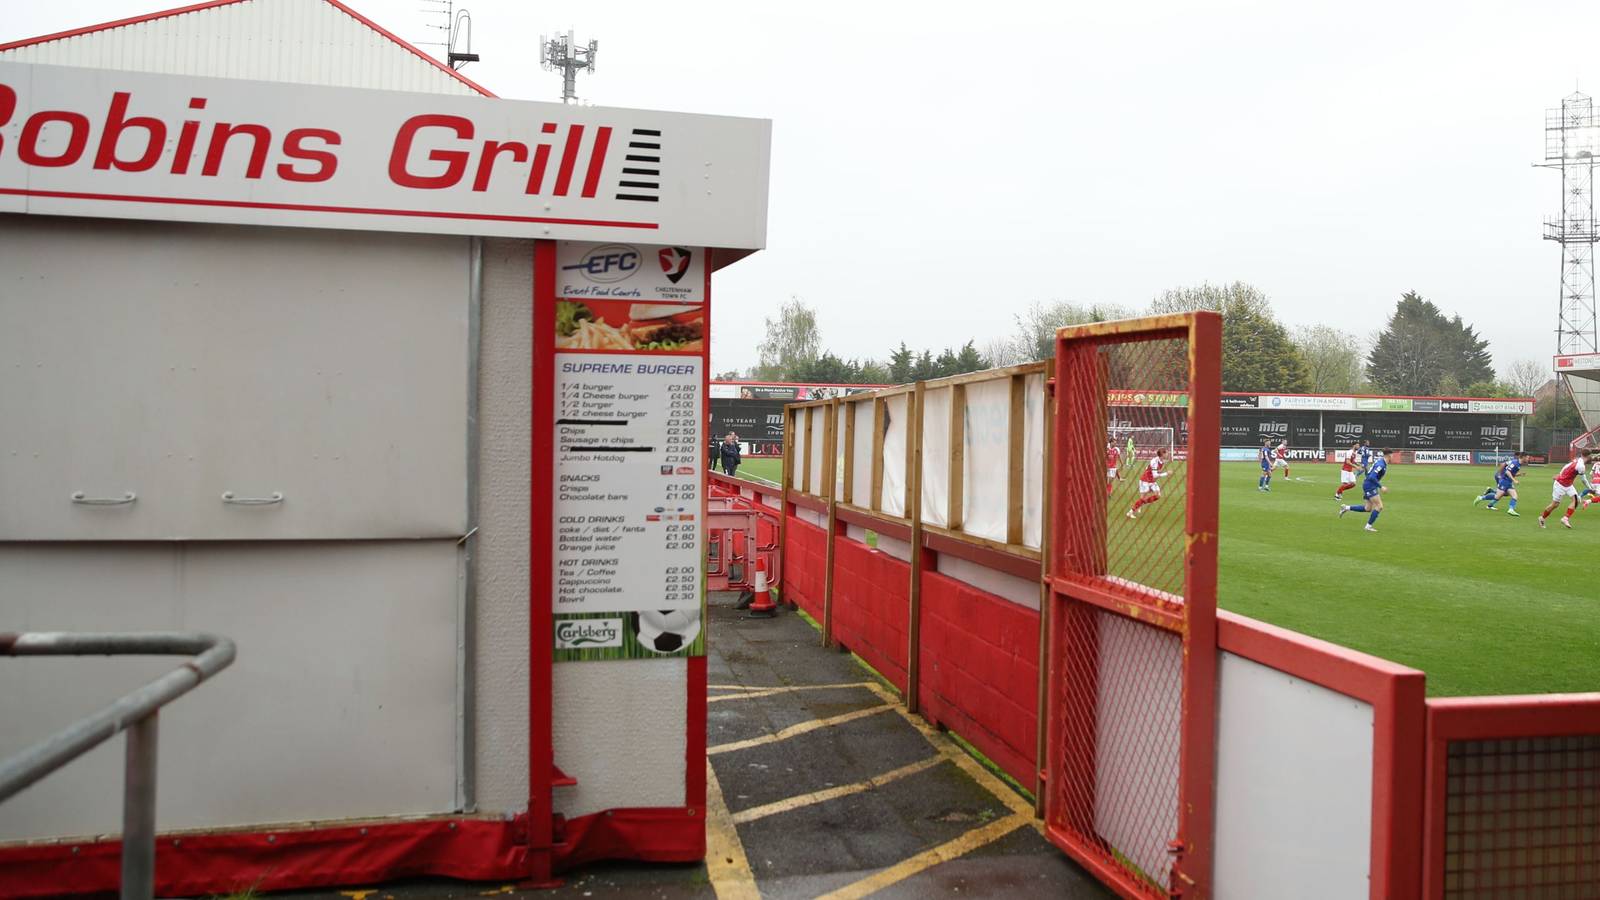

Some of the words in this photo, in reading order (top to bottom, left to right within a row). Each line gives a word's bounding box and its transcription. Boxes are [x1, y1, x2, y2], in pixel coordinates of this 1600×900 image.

[388, 113, 613, 200] Grill
[586, 252, 637, 274] EFC
[563, 285, 590, 296] Event
[590, 286, 610, 296] Food
[612, 288, 641, 297] Courts
[562, 362, 632, 374] SUPREME
[637, 364, 695, 374] BURGER
[582, 384, 614, 392] burger
[618, 393, 649, 401] burger
[582, 401, 614, 409] burger
[616, 410, 648, 418] burger
[560, 427, 585, 435] Chips
[1259, 421, 1288, 432] mira
[1334, 422, 1364, 433] mira
[1408, 424, 1436, 435] mira
[1481, 425, 1508, 436] mira
[1271, 450, 1326, 459] SORTFIVE
[1416, 453, 1449, 461] RAINHAM
[1450, 453, 1469, 461] STEEL
[559, 544, 592, 552] Orange
[594, 544, 615, 552] juice
[559, 578, 611, 586] Cappuccino
[557, 622, 617, 642] Carlsberg
